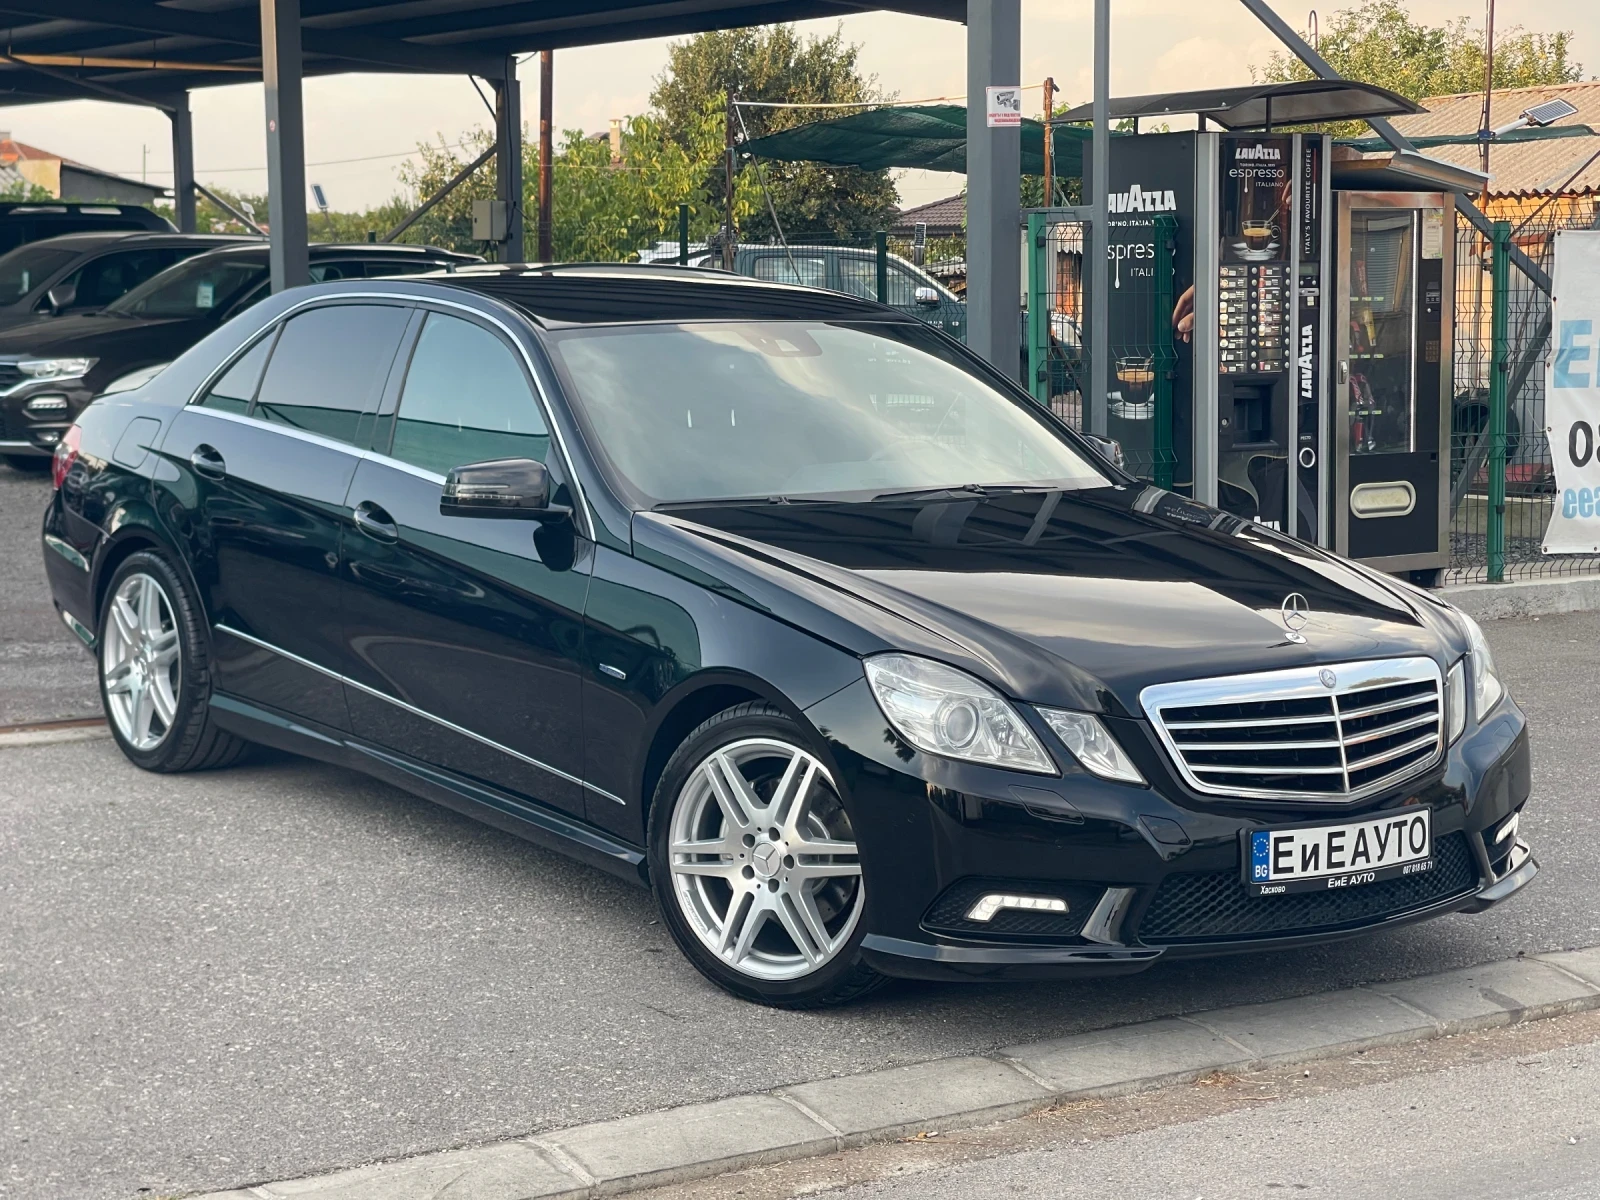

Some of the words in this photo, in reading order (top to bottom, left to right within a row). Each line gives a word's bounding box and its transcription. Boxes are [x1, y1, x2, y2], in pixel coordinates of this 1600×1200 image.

[1235, 143, 1281, 160] LAVAZZA
[1229, 168, 1285, 182] espresso
[1107, 184, 1177, 213] AVAZZA
[1298, 324, 1313, 399] LAVAZZA
[1255, 864, 1268, 877] BG
[1327, 876, 1348, 888] ЕиЕ
[1349, 872, 1376, 885] АУТО
[1260, 885, 1286, 895] Хасково
